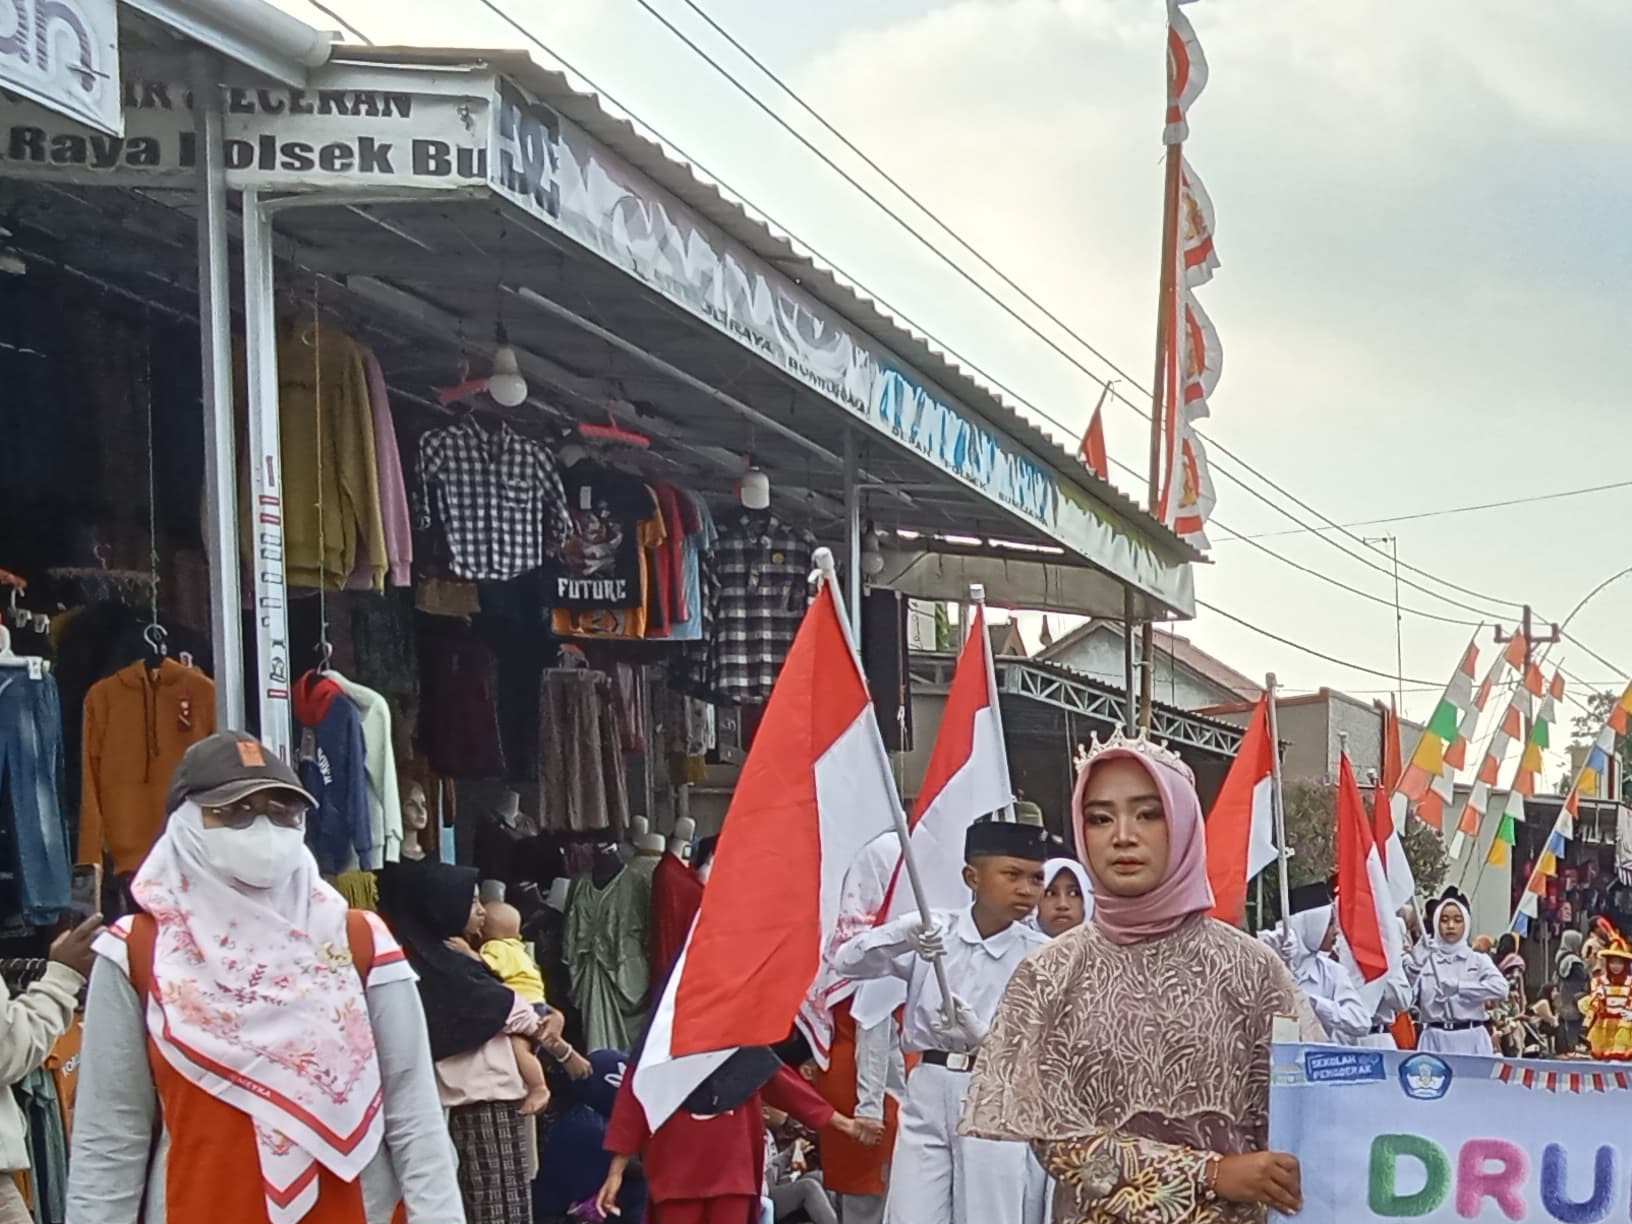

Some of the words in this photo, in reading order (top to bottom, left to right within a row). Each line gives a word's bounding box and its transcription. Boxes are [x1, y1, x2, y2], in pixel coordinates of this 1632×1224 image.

[8, 126, 162, 169] Raya
[179, 131, 394, 174] olsek
[557, 577, 627, 602] FUTURE
[1311, 1055, 1357, 1069] SEKOLAH
